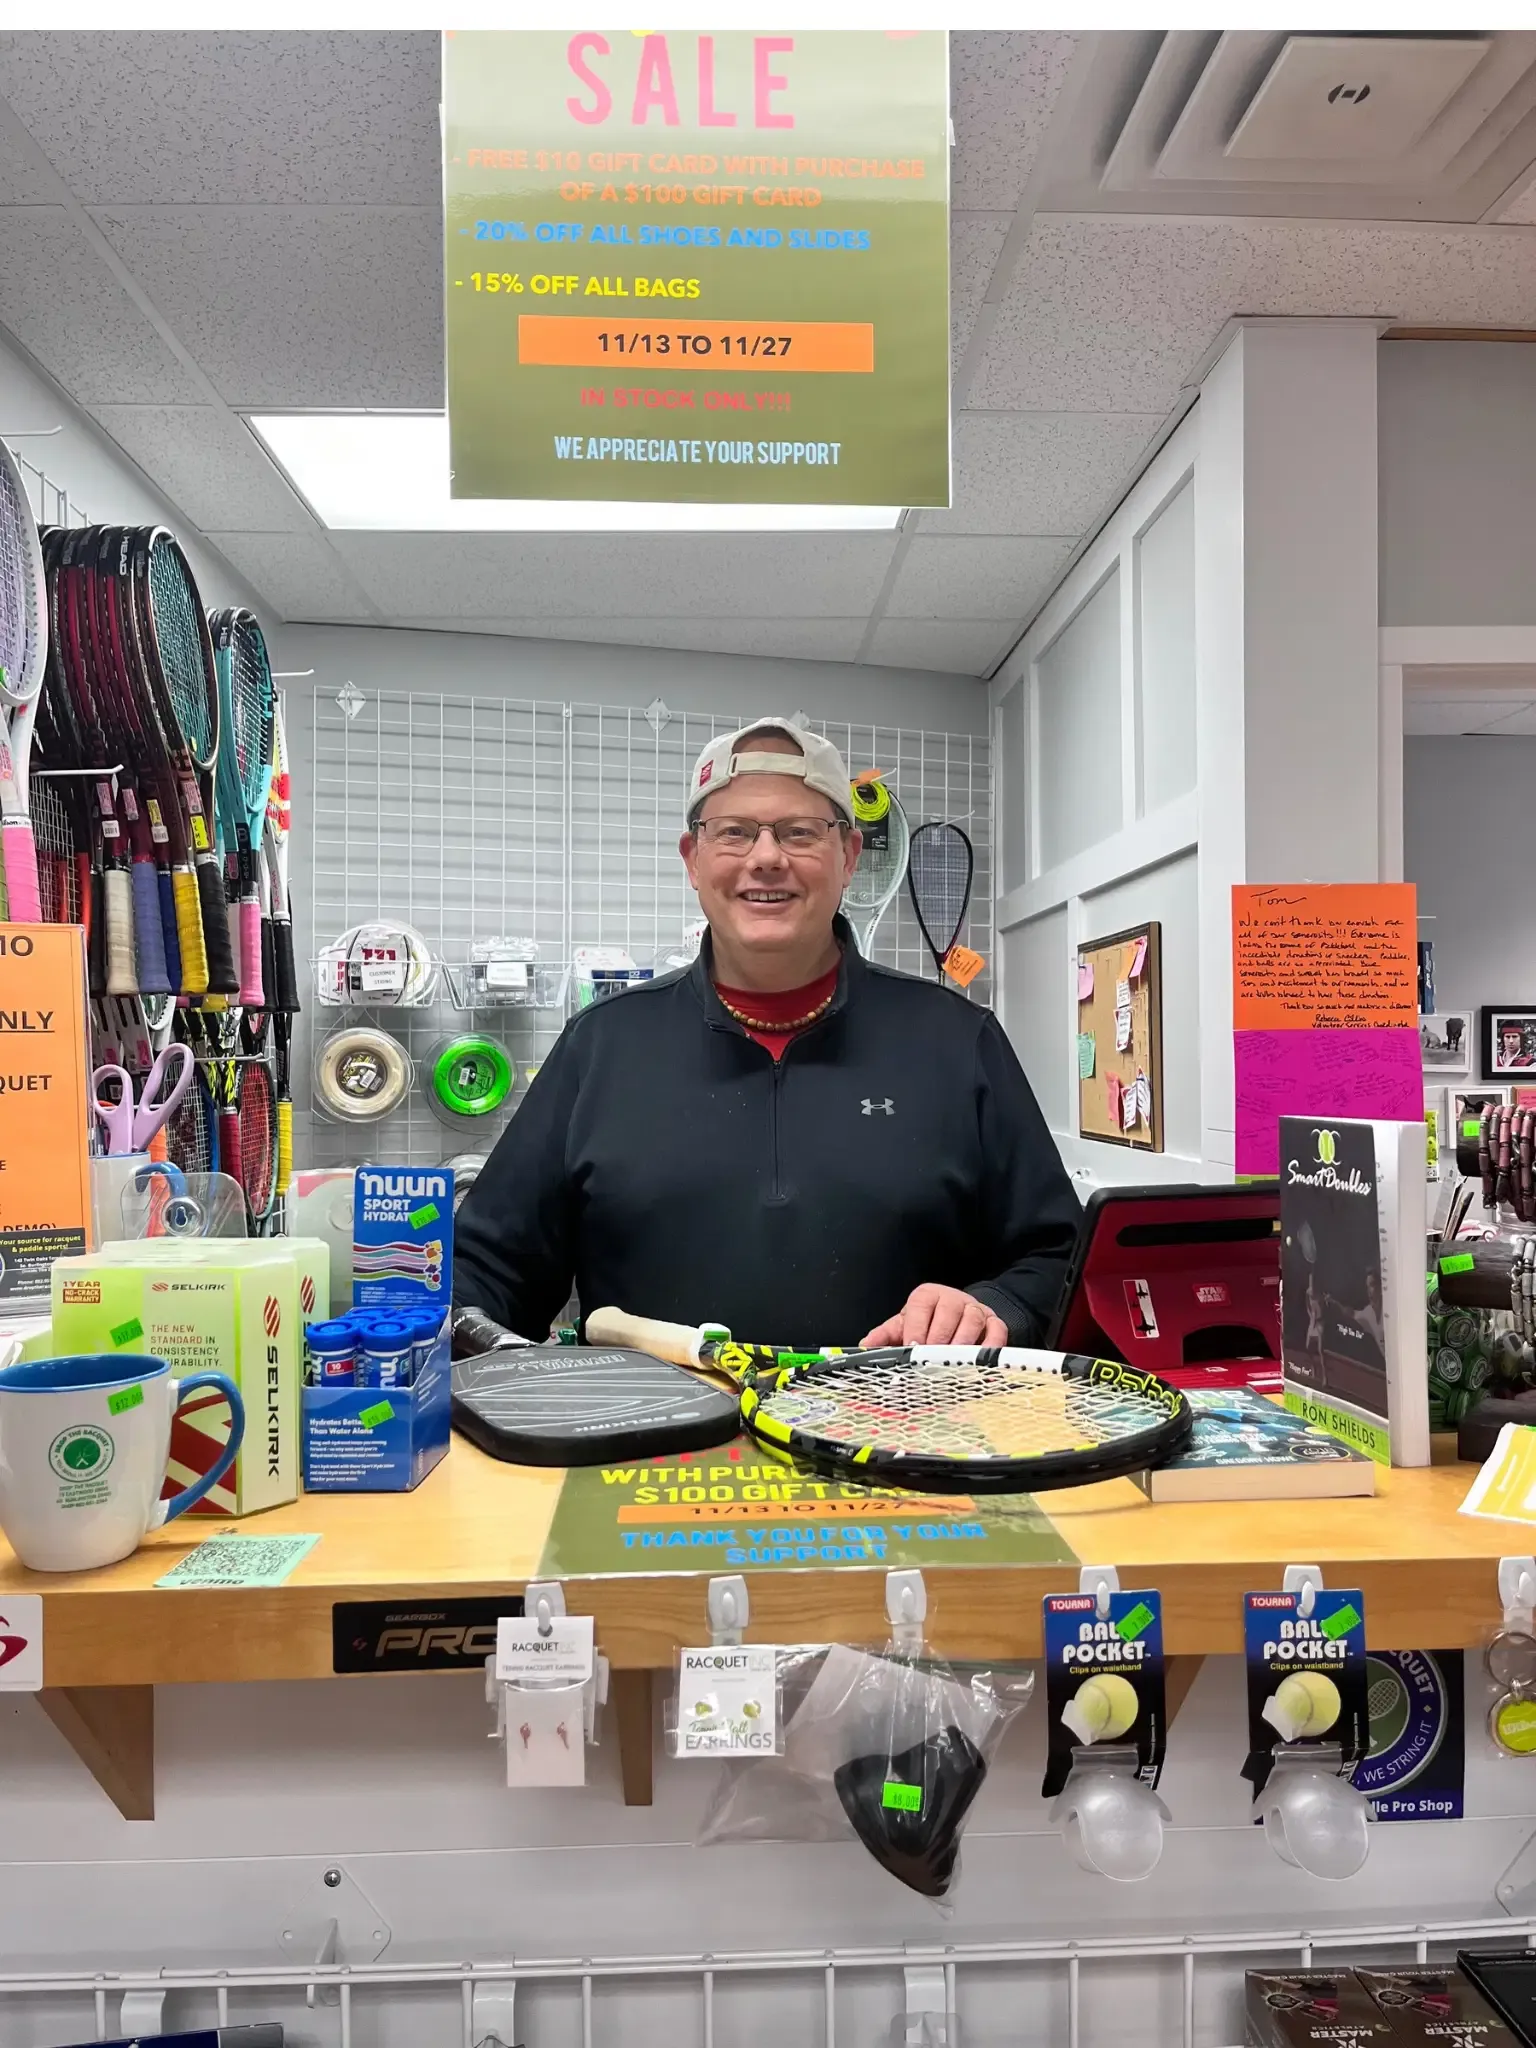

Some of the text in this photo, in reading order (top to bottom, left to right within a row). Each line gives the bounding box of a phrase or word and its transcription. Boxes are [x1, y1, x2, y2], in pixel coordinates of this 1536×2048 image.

[566, 32, 795, 129] SALE
[467, 149, 926, 180] FREE $10 GIFT CARD WITH PURCHASE
[560, 181, 822, 207] OF A $100 GIFT CARD
[475, 220, 871, 250] 20% OFF ALL SHOES AND SLIDES
[470, 272, 700, 298] 15% OFF ALL BAGS
[597, 333, 792, 357] 11/13 TO 11/27
[580, 388, 791, 411] IN STOCK ONLY!!!
[554, 436, 841, 465] WE APPRECIATE YOUR SUPPORT
[1251, 888, 1307, 907] Tom
[1239, 912, 1259, 927] We
[1289, 916, 1323, 926] thank
[363, 1173, 447, 1197] nuun
[363, 1199, 411, 1211] SPORT
[54, 1235, 81, 1243] racquet
[20, 1245, 43, 1254] paddle
[171, 1283, 226, 1291] SELKIRK
[151, 1324, 195, 1333] THE NEW
[151, 1335, 215, 1344] STANDARD IN
[150, 1347, 219, 1356] CONSISTENCY
[170, 1358, 223, 1367] URABILITY.
[266, 1345, 280, 1477] SELKIRK
[310, 1427, 328, 1435] Than
[1303, 1402, 1375, 1449] RON SHIELDS
[601, 1467, 701, 1484] WITH
[741, 1483, 829, 1501] GIFT
[690, 1505, 770, 1515] 11/13
[621, 1523, 989, 1548] THANK YOU FOR YOUR
[725, 1543, 888, 1565] SUPPORT
[1051, 1599, 1091, 1610] TOURNA
[1251, 1596, 1292, 1607] TOURNA
[385, 1612, 448, 1623] GEARBOX
[1079, 1621, 1121, 1642] BAL
[512, 1642, 559, 1655] RACQUET
[1062, 1640, 1146, 1664] POCKET
[1263, 1639, 1348, 1660] POCKET
[686, 1655, 748, 1669] RACQUET
[1069, 1665, 1090, 1674] Clips
[1102, 1663, 1142, 1672] waistband
[1270, 1662, 1292, 1672] Clips
[1304, 1661, 1344, 1670] waistband
[1388, 1649, 1435, 1694] QUET
[1363, 1719, 1433, 1783] WE STRING IT
[1393, 1800, 1453, 1813] Pro Shop
[1309, 2028, 1373, 2040] MASTER
[1425, 2025, 1490, 2037] MASTER
